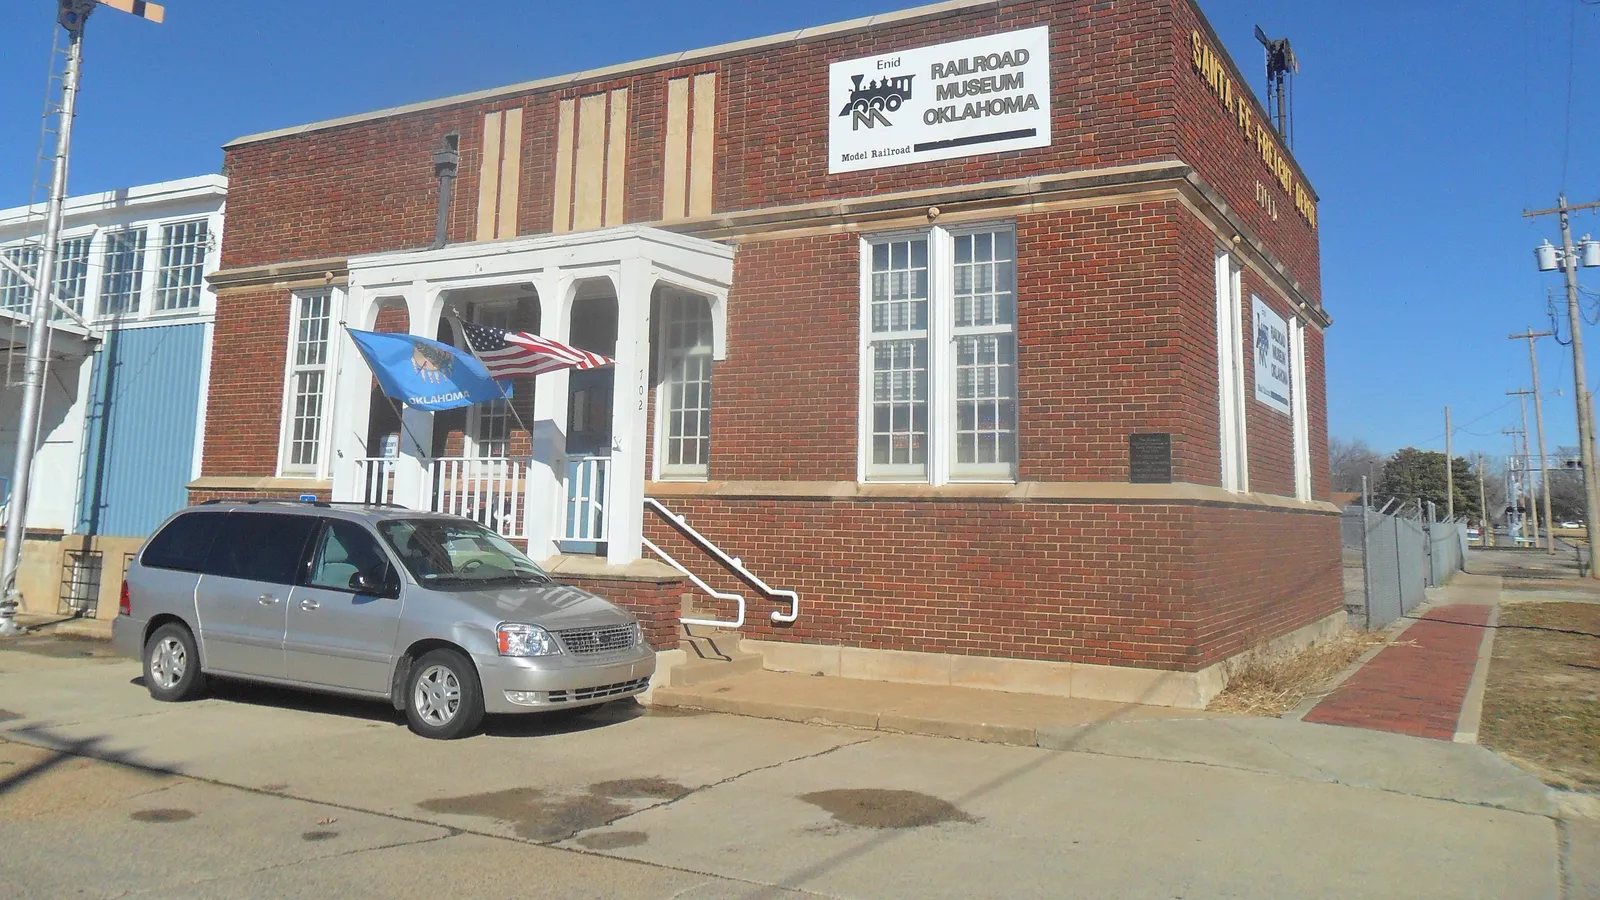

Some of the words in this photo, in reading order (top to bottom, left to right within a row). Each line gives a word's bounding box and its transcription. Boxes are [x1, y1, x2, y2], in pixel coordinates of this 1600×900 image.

[877, 57, 901, 70] Enid
[931, 48, 1029, 80] RAILROAD
[936, 72, 1024, 101] MUSEUM
[923, 93, 1039, 126] OKLAHOMA
[1192, 30, 1233, 114] SANTA
[1239, 95, 1252, 140] FE
[1257, 123, 1292, 196] FREIGHT
[841, 151, 867, 162] Model
[871, 145, 911, 158] Railroad
[408, 390, 470, 405] OKLAHOMA
